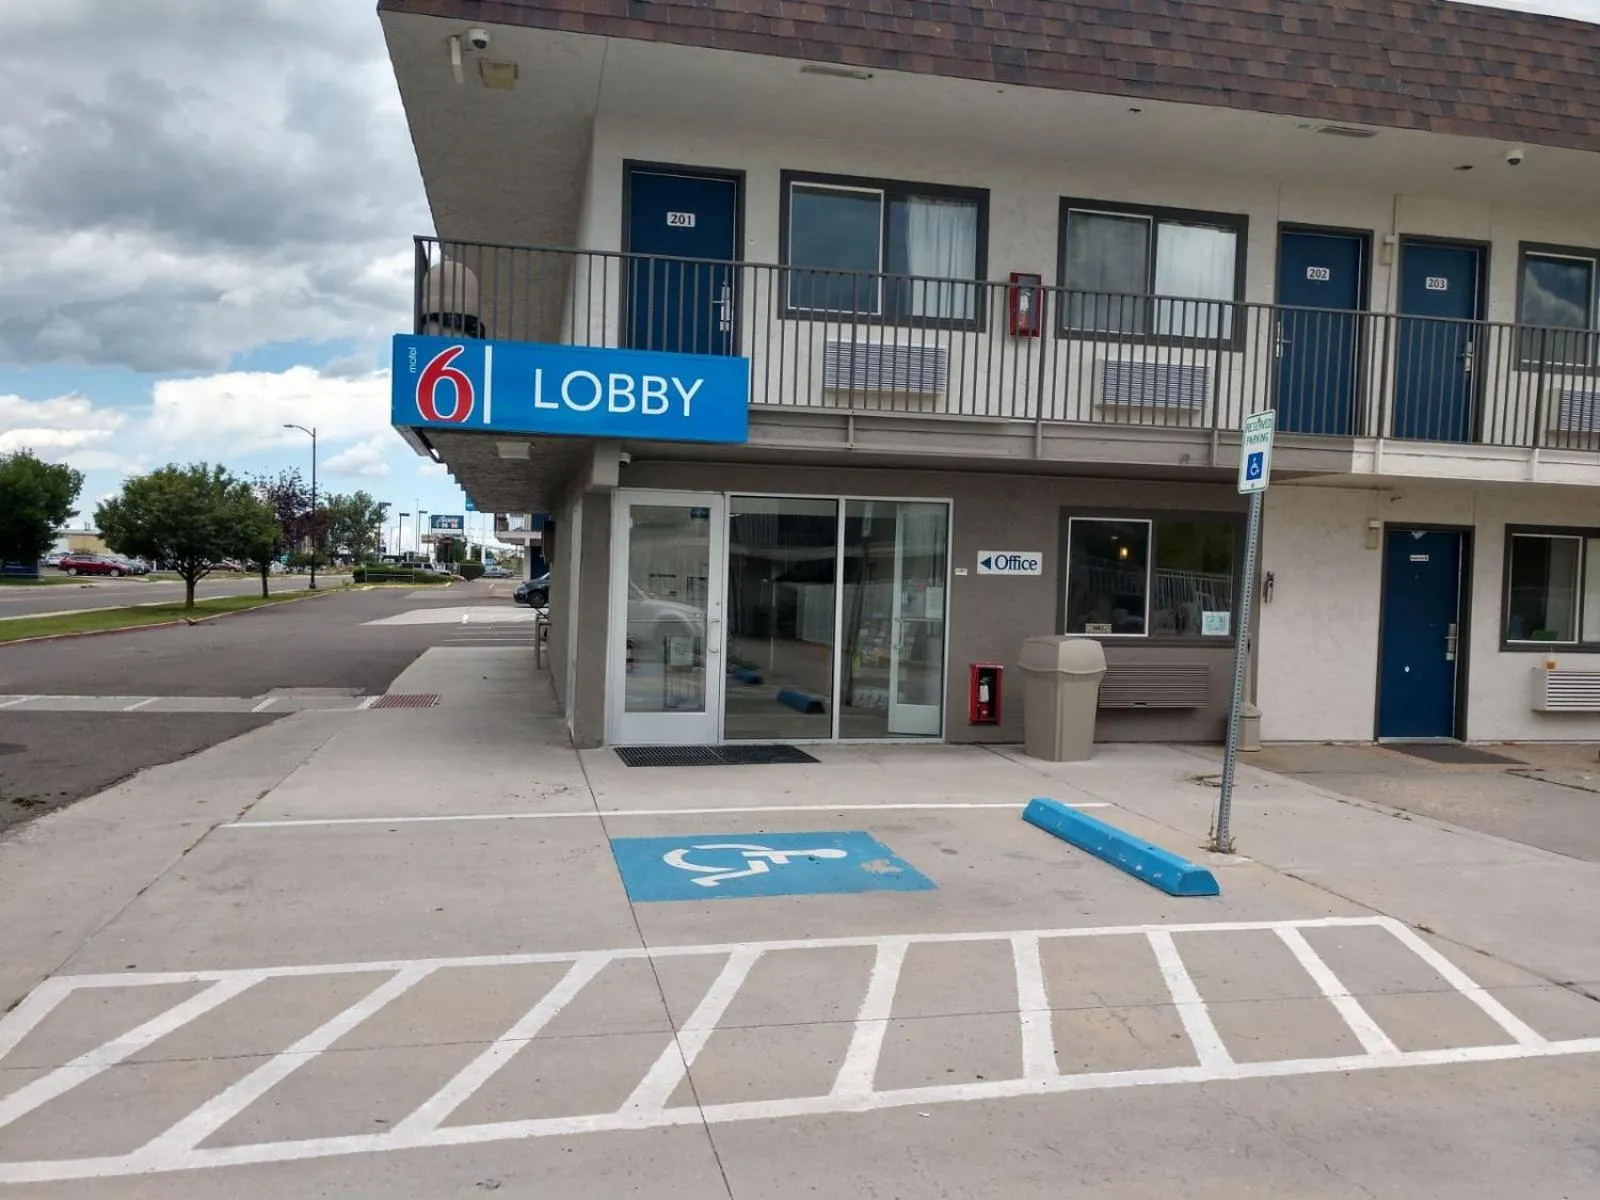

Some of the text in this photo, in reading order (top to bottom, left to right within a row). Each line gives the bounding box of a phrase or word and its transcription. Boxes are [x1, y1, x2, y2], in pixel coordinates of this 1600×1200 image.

[670, 214, 692, 225] 201
[1308, 269, 1328, 279] 202
[1427, 279, 1446, 289] 203
[408, 346, 417, 374] motel
[415, 344, 475, 424] 6
[534, 368, 704, 417] LOBBY
[1246, 432, 1270, 444] PARKING
[995, 554, 1038, 571] Office
